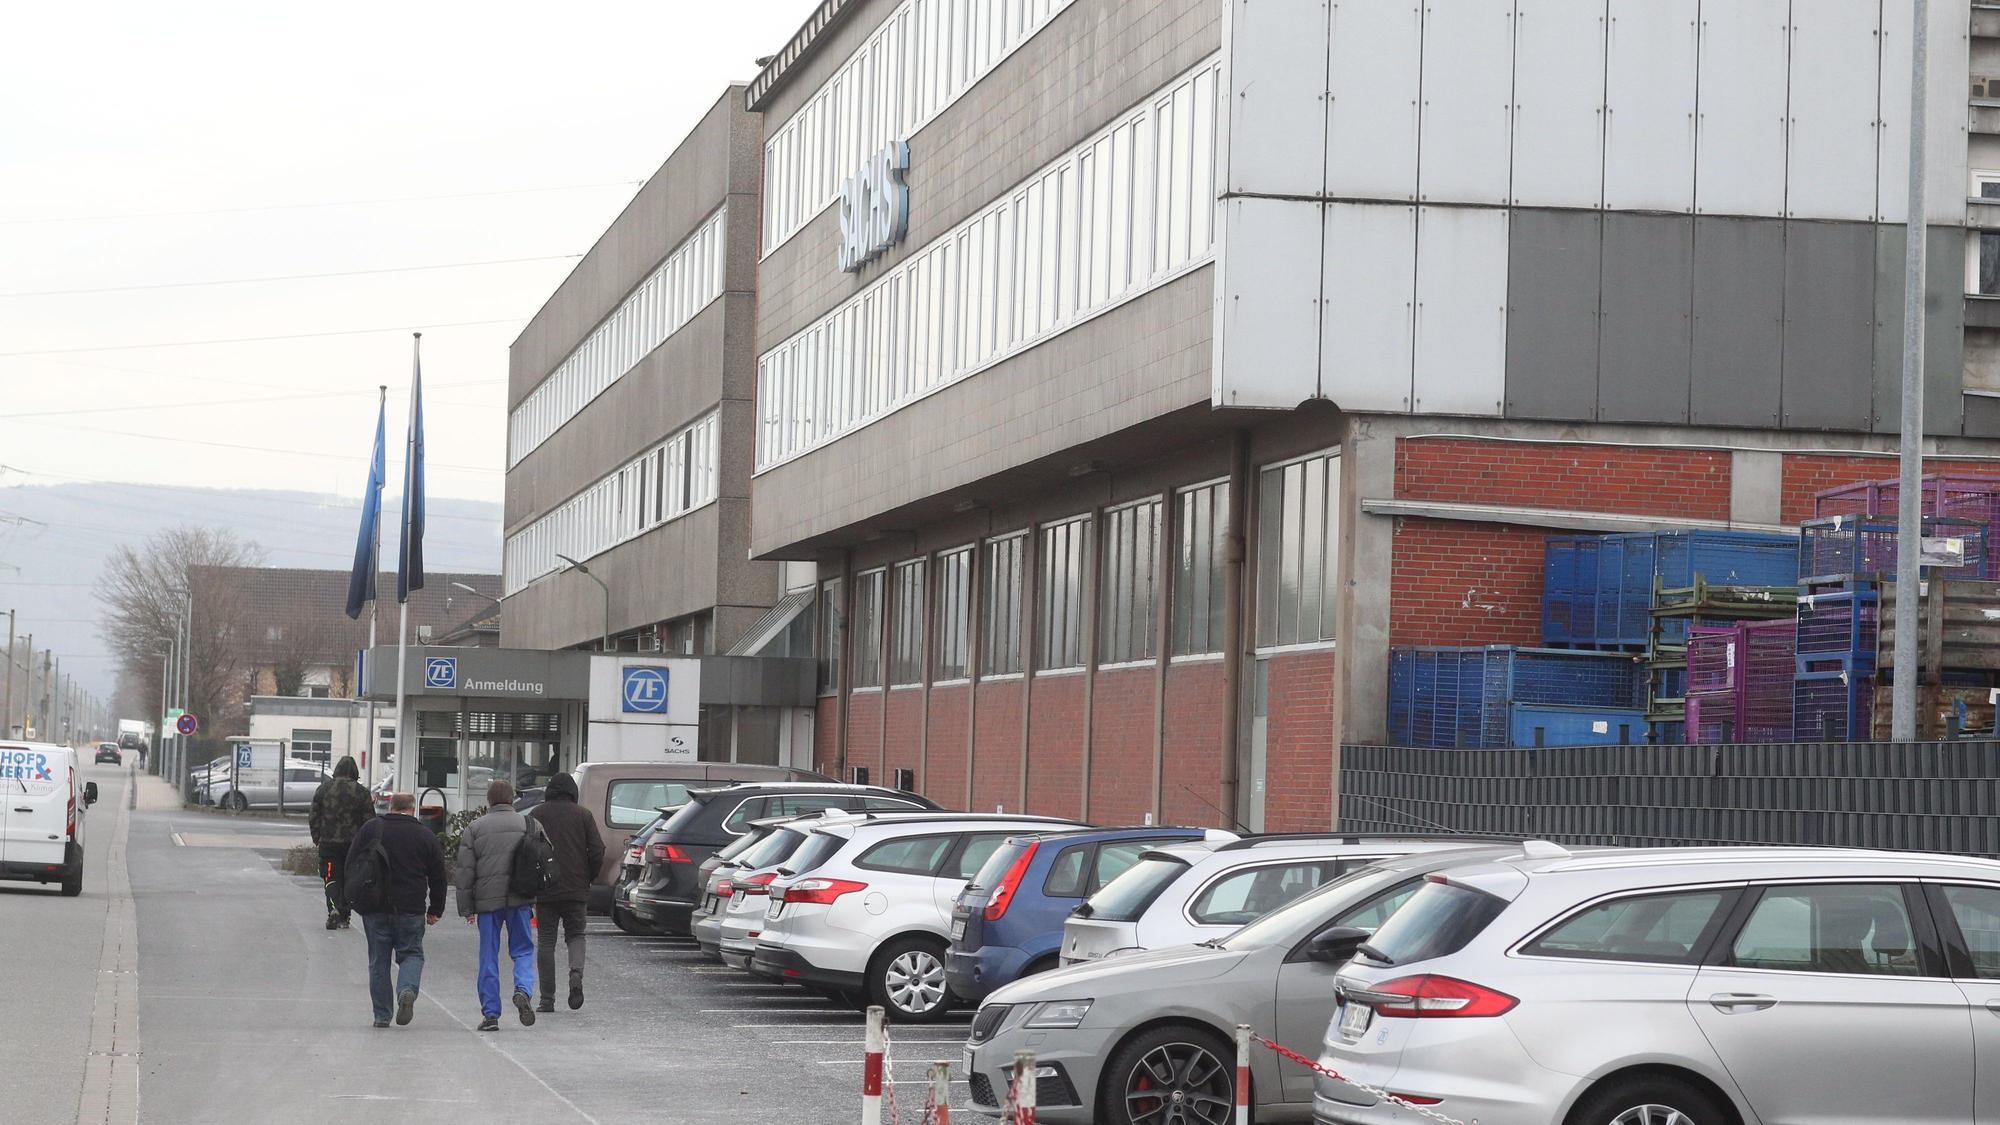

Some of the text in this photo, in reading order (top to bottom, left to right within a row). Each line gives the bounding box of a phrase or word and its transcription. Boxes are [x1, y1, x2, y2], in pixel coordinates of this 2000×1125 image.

[838, 140, 909, 272] SACHS
[429, 663, 454, 682] ZF
[464, 678, 544, 694] Anmeldung
[627, 676, 664, 704] ZF
